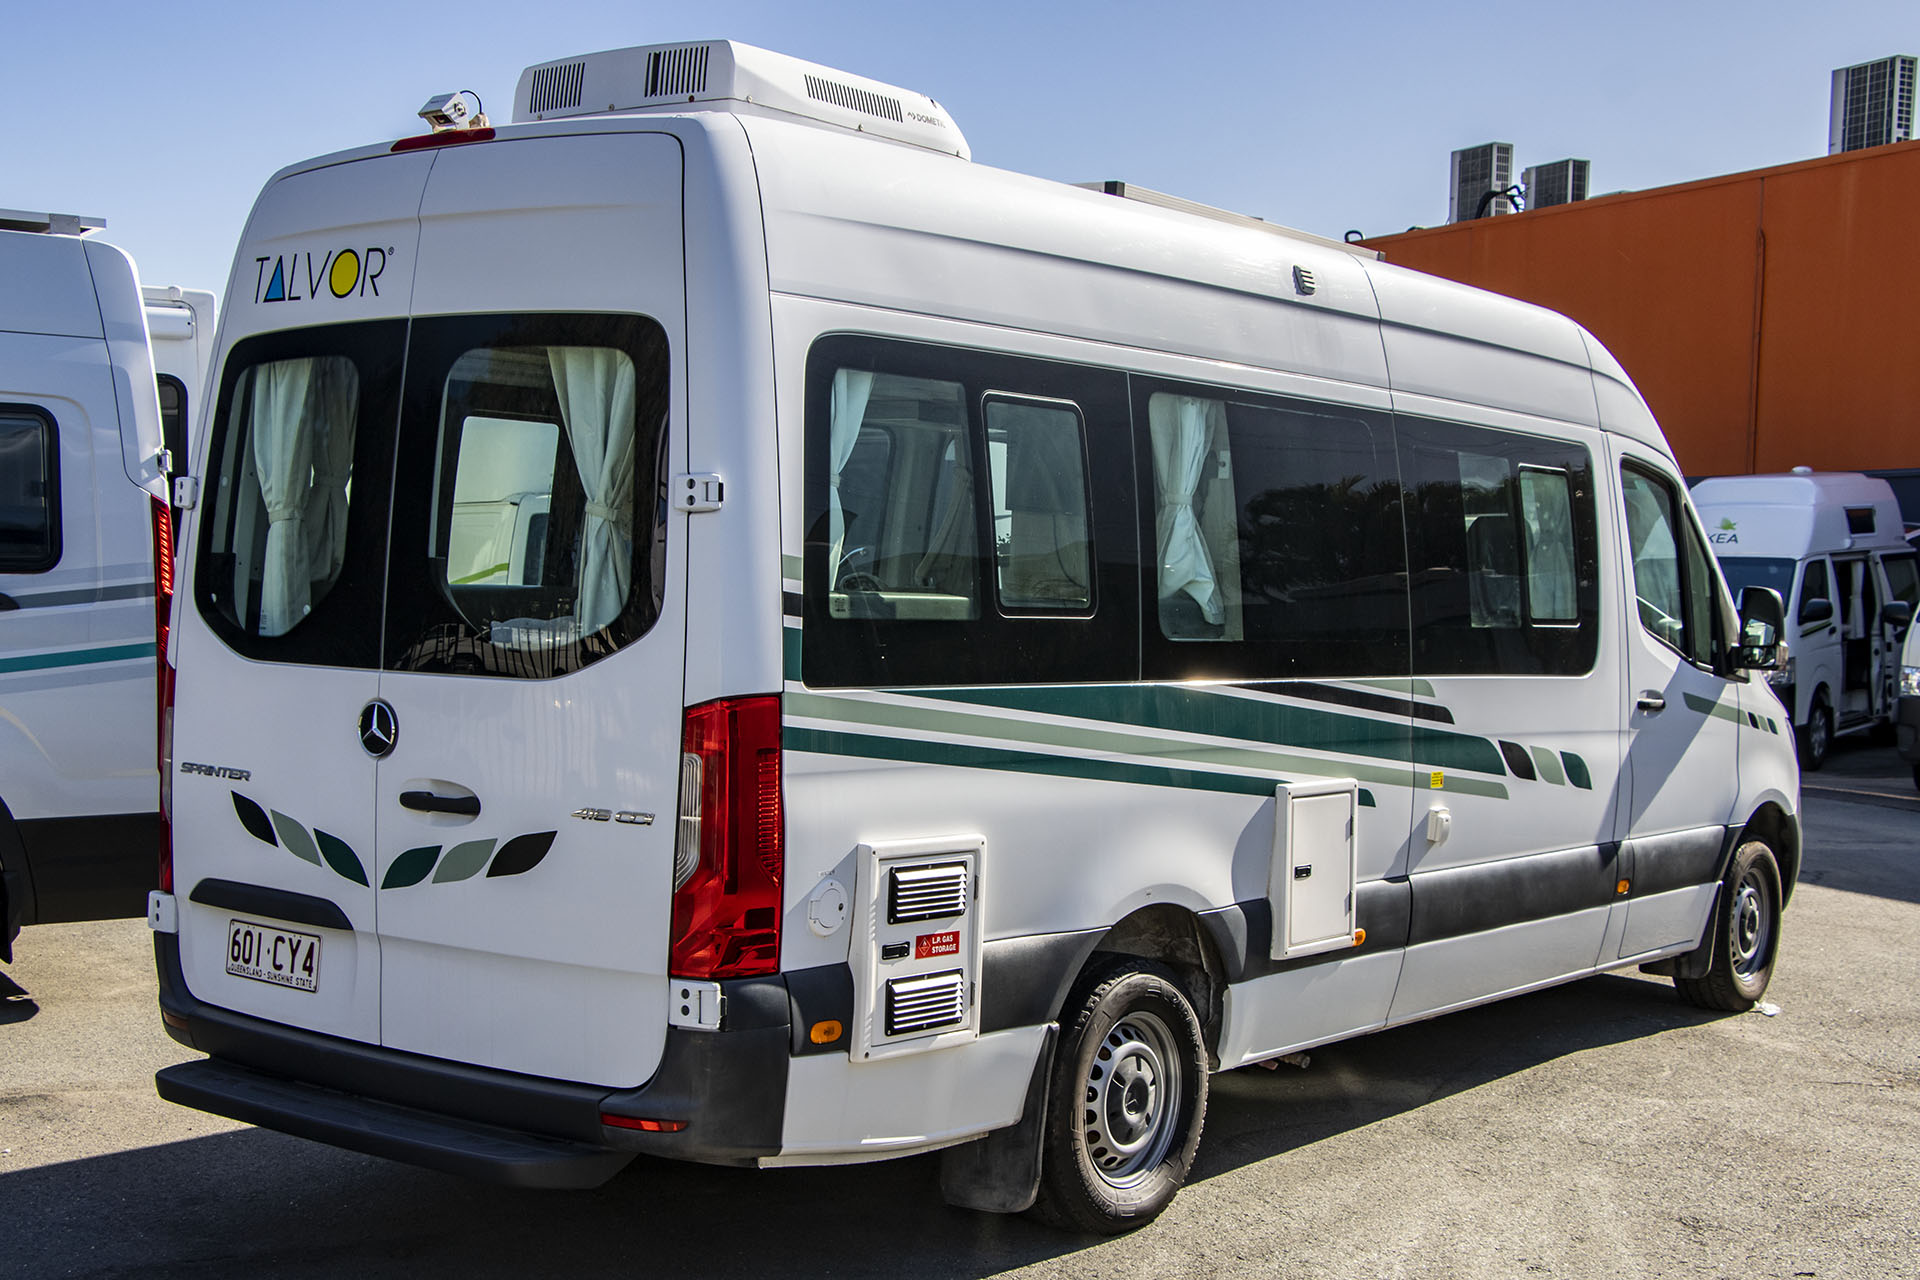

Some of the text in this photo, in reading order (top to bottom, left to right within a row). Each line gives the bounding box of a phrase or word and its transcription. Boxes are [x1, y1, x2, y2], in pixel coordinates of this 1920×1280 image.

[255, 248, 386, 304] TALVOR
[180, 762, 252, 781] SPRINTER
[615, 811, 655, 826] CDI
[932, 944, 956, 953] STORAGE
[231, 963, 313, 988] QUEENSLAND SUNSHINE STATE
